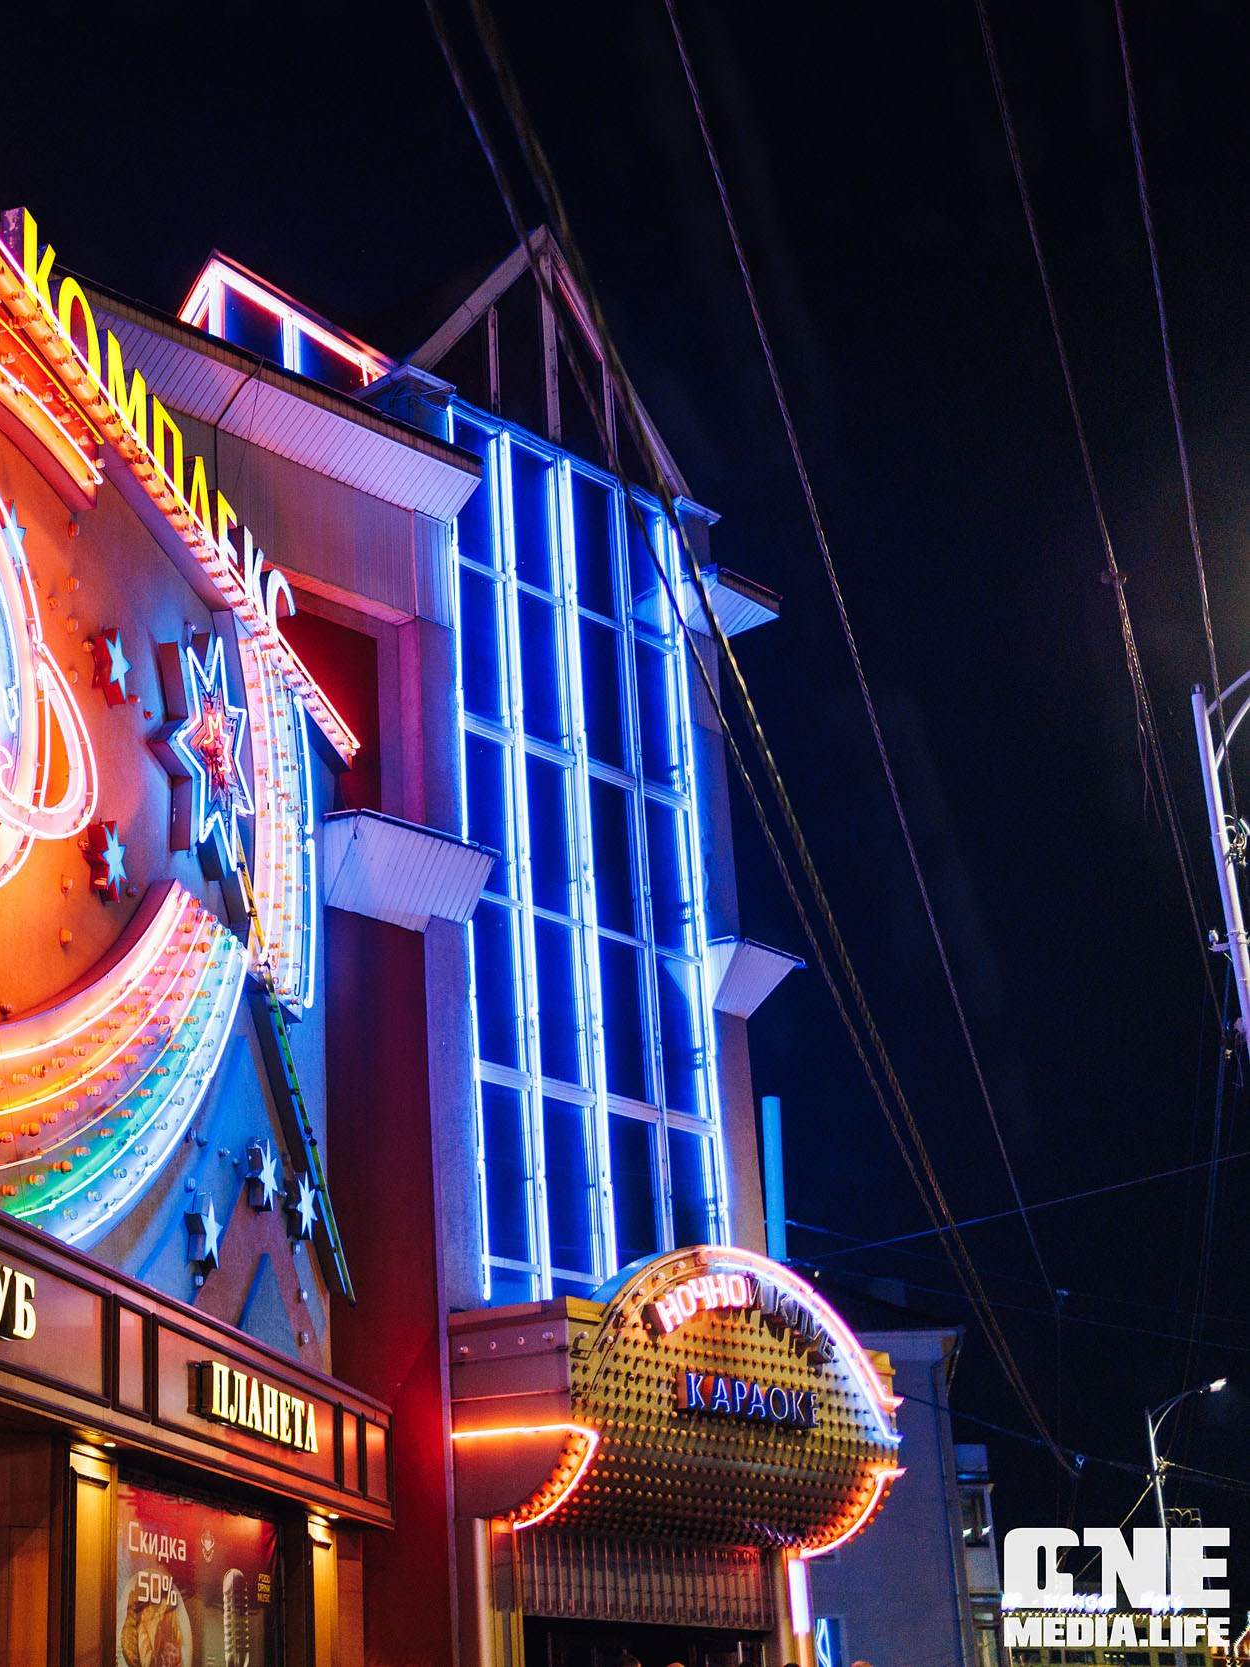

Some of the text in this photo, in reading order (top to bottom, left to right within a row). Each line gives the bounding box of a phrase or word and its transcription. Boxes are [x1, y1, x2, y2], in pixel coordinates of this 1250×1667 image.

[211, 1360, 319, 1454] ПЛАНЕТА
[685, 1371, 821, 1428] КАРАОКЕ
[128, 1520, 187, 1563] Скидка
[137, 1570, 178, 1607] 50%
